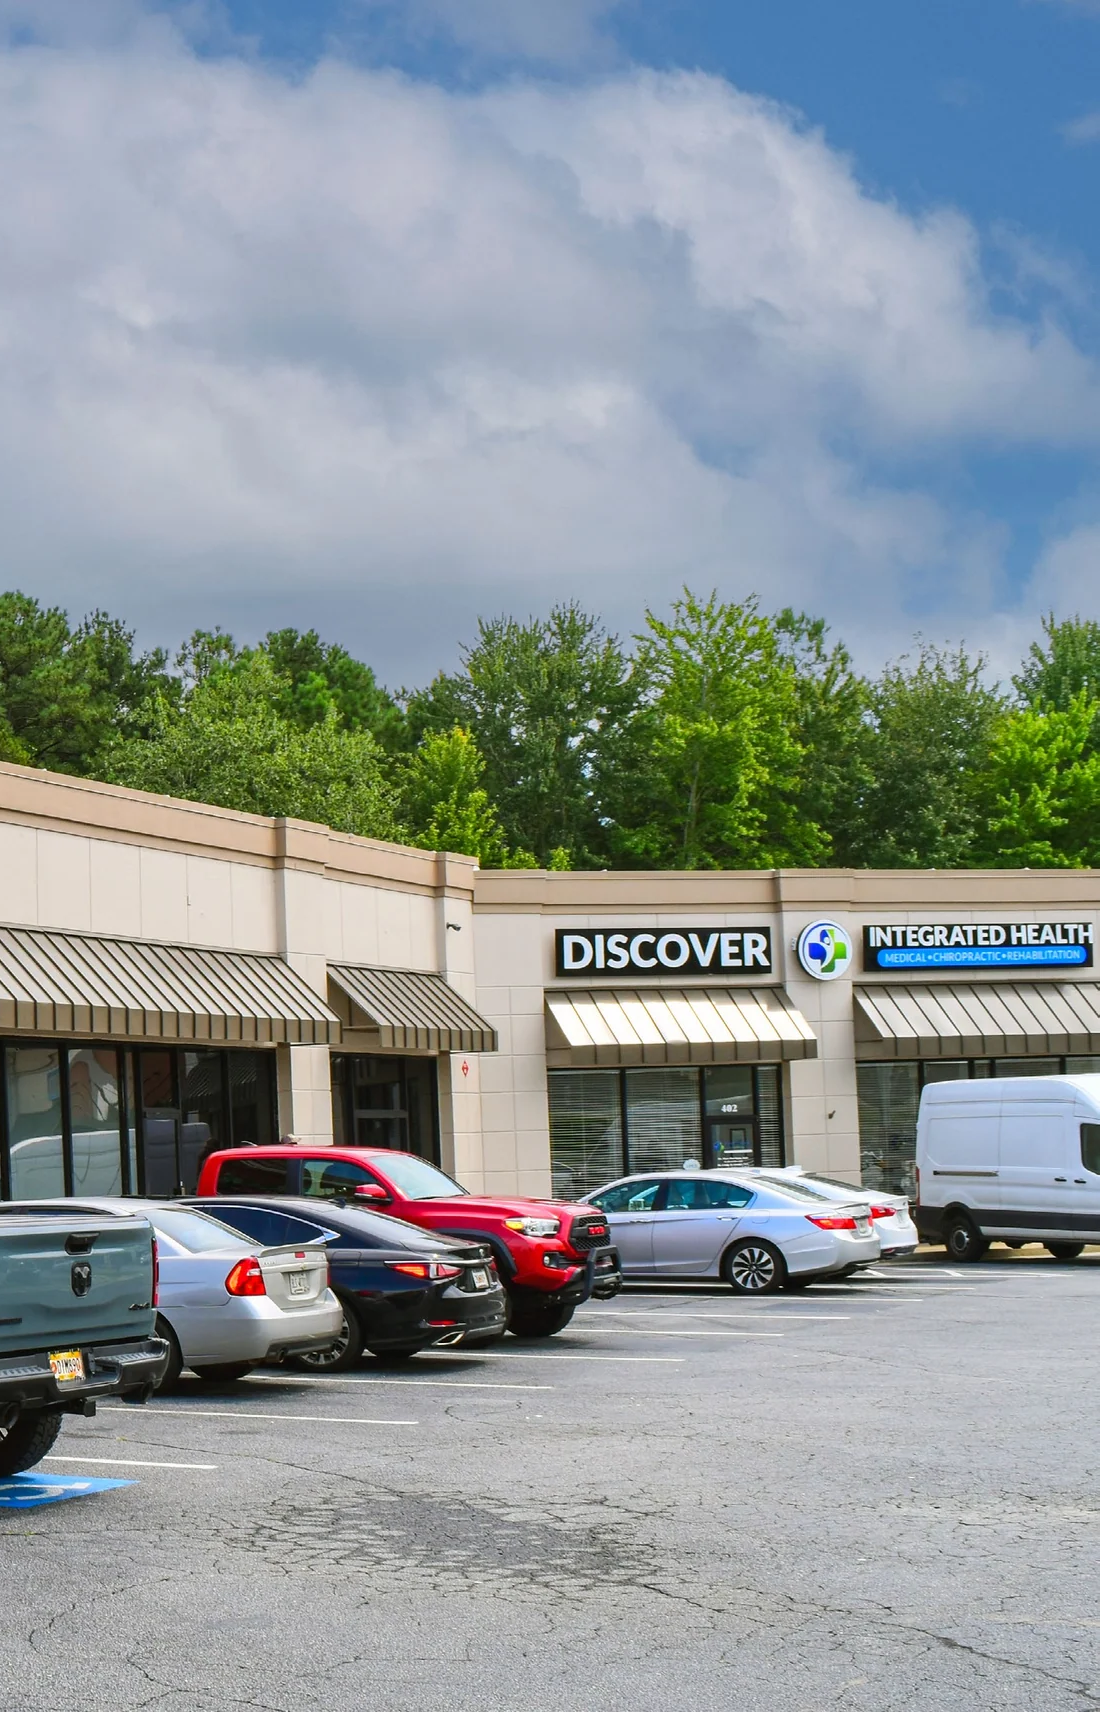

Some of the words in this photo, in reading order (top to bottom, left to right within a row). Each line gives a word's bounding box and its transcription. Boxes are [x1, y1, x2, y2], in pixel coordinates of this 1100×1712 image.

[869, 925, 1007, 948] INTEGRATED
[1010, 923, 1094, 946] HEALTH
[563, 933, 771, 970] DISCOVER
[884, 952, 927, 964] MEDICAL
[932, 951, 1002, 962] CHIROPRACTIC
[1006, 949, 1081, 961] REHABILITATION
[721, 1104, 738, 1113] 402
